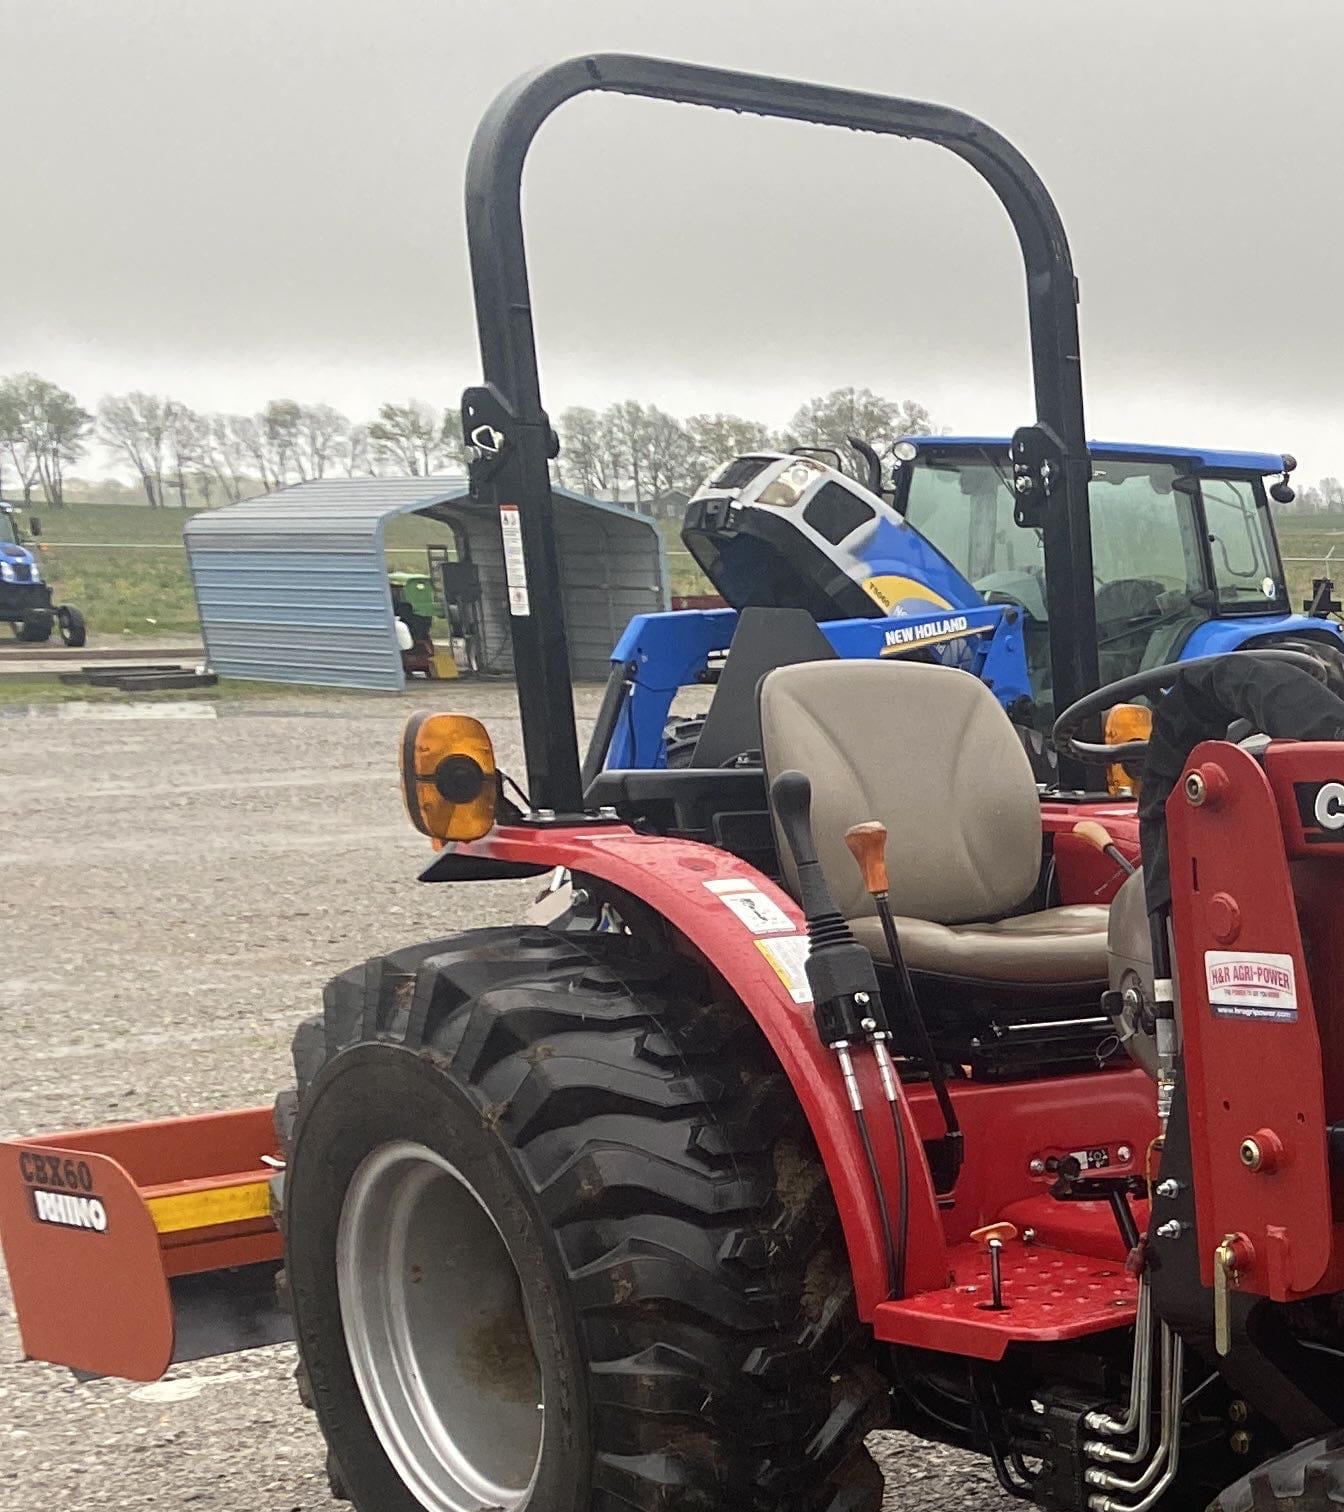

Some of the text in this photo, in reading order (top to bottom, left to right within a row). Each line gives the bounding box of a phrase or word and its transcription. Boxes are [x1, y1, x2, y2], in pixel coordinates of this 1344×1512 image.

[885, 616, 967, 646] NEW HOLLAND
[1211, 965, 1290, 990] H&R AGRI-POWER
[20, 1151, 93, 1192] CBX60
[34, 1190, 107, 1231] RHINO
